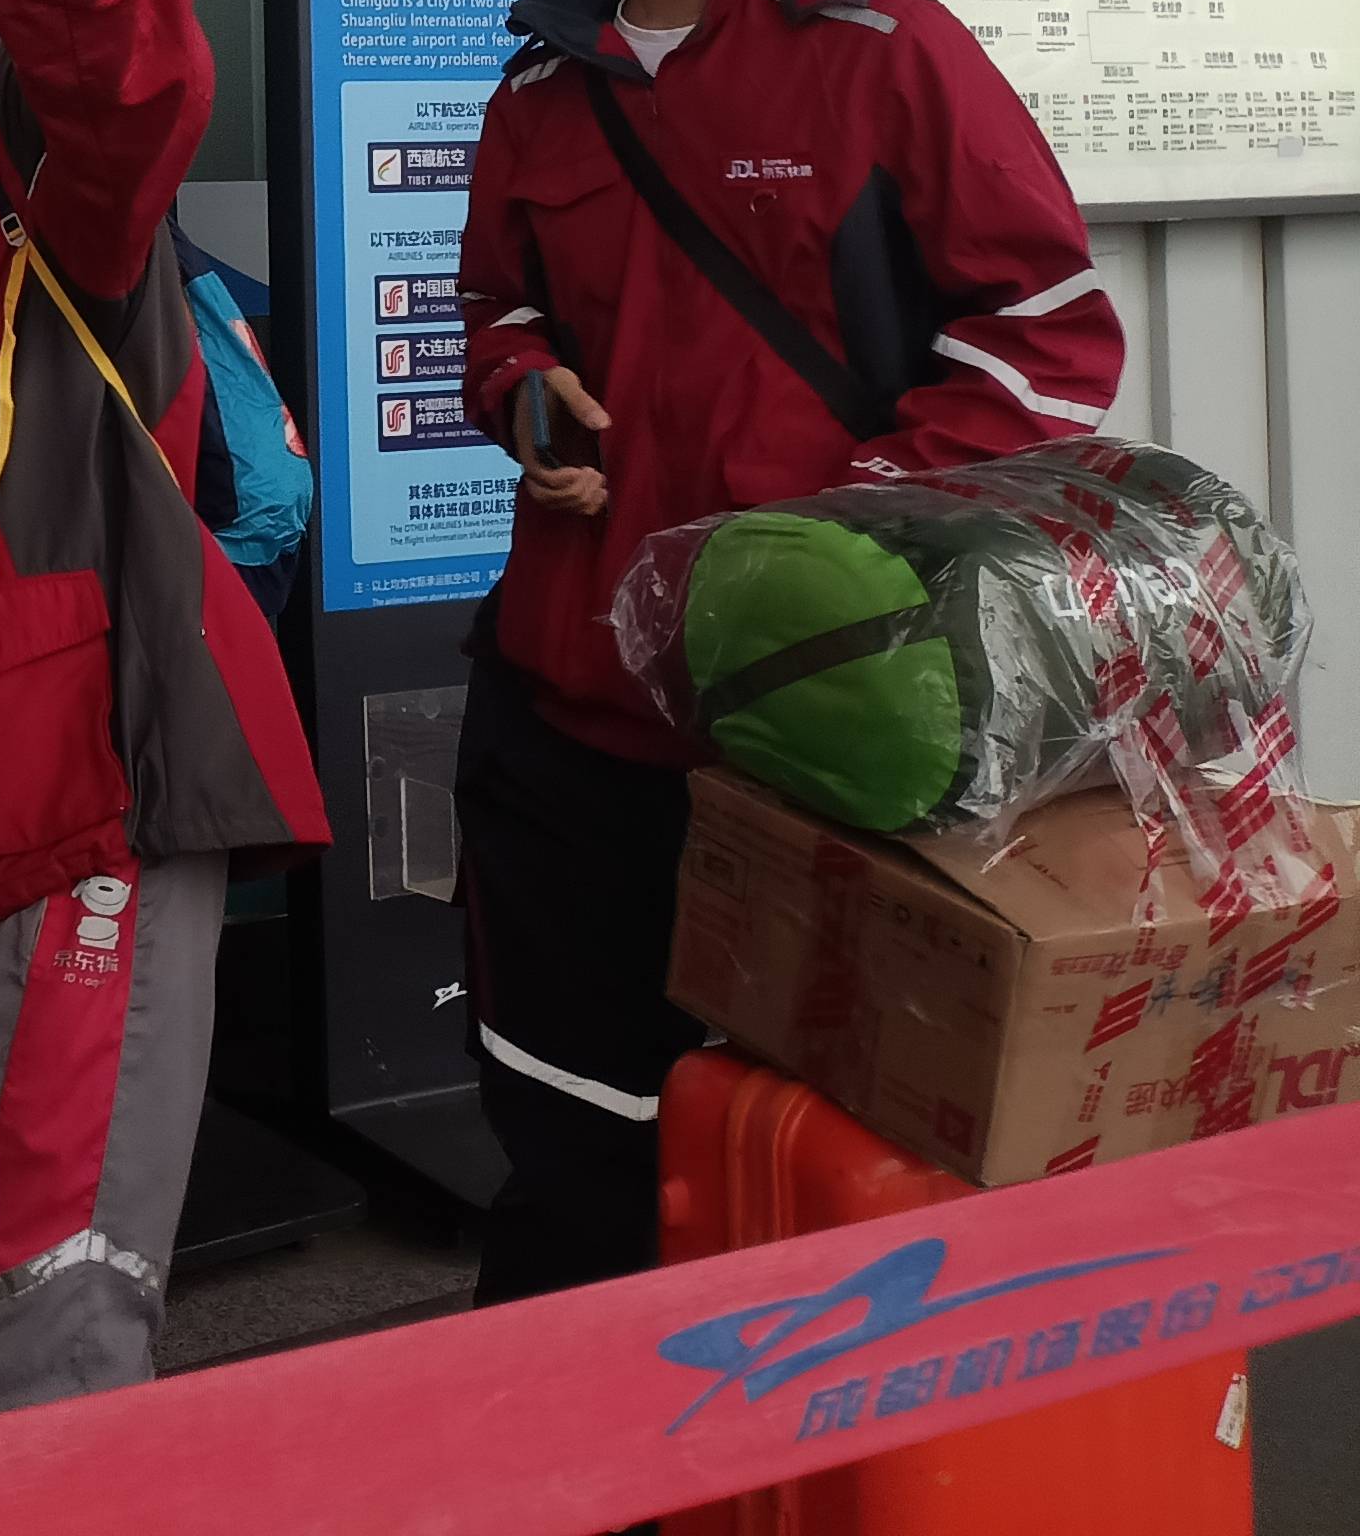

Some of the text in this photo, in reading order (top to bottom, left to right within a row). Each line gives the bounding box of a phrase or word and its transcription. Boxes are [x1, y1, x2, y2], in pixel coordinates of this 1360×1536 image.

[341, 12, 493, 29] Shuangliu International
[341, 33, 407, 49] departure
[412, 33, 456, 50] airport
[463, 33, 486, 47] and
[342, 54, 376, 66] there
[379, 55, 411, 66] were
[414, 54, 437, 69] any
[406, 149, 466, 169] 西藏航空
[726, 159, 760, 180] JDL
[407, 175, 432, 186] TIBET
[413, 303, 456, 314] AIR CHINA
